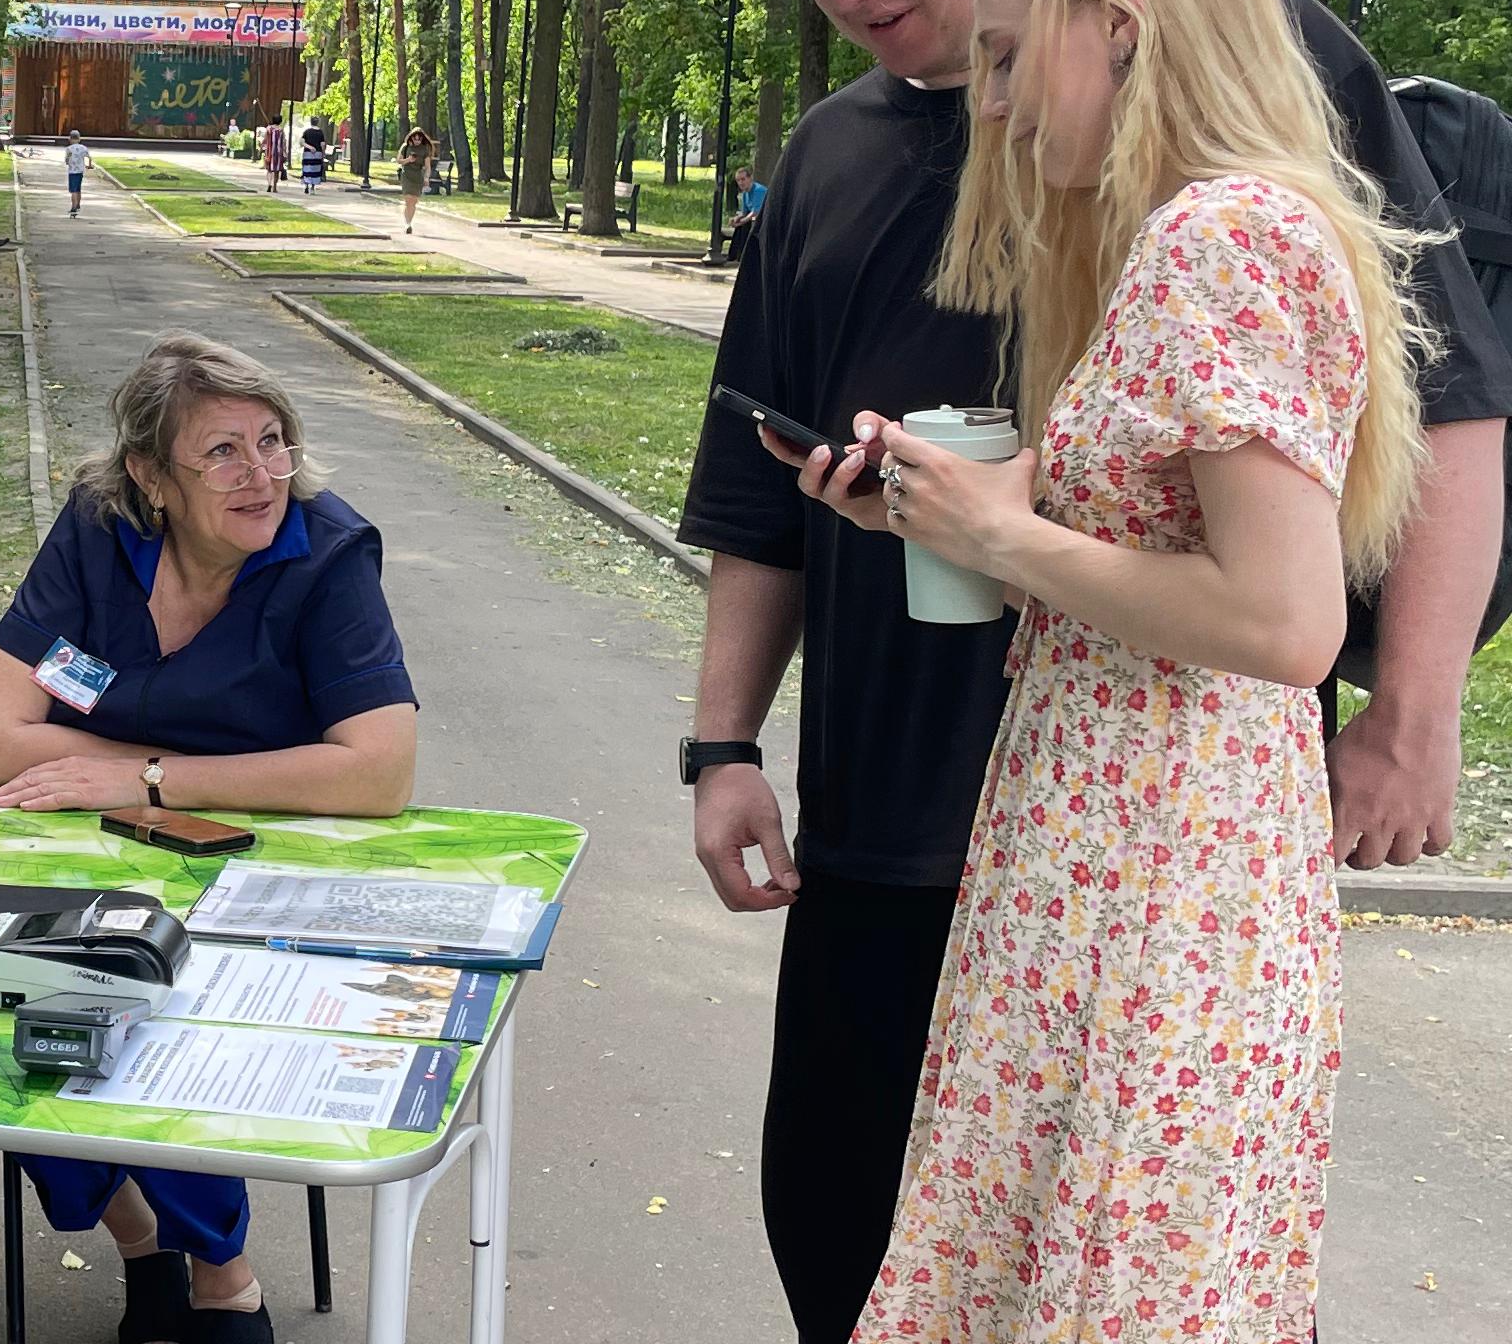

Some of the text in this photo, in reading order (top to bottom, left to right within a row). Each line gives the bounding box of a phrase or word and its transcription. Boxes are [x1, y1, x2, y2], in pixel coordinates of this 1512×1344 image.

[113, 15, 186, 32] цвети,
[194, 17, 237, 30] моя
[50, 1042, 80, 1053] СБЕР
